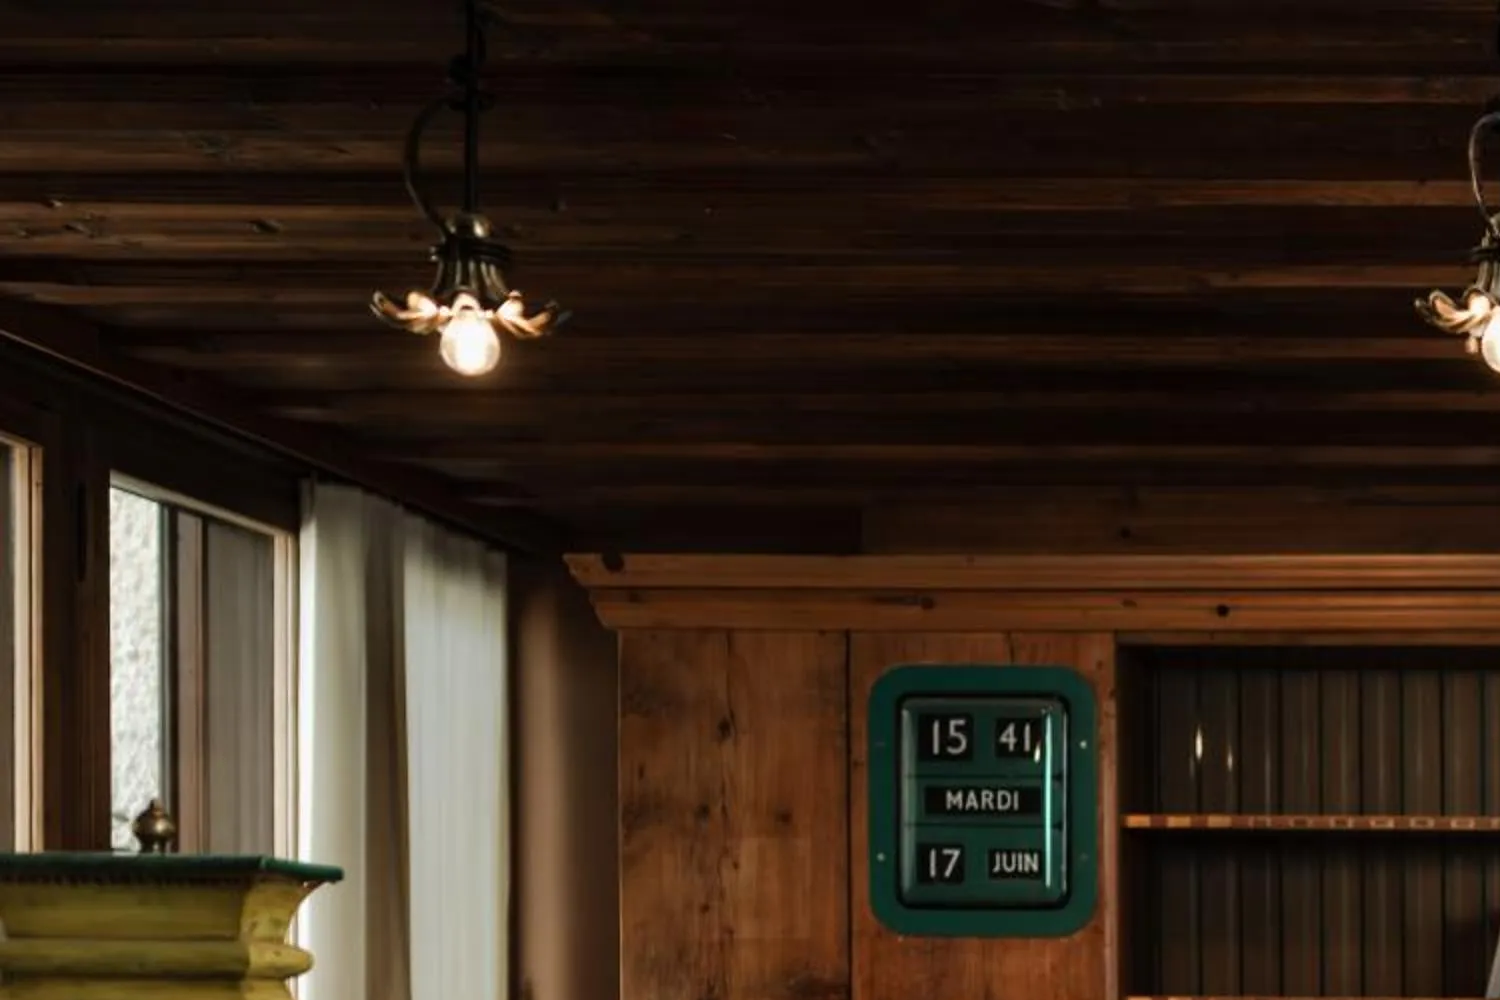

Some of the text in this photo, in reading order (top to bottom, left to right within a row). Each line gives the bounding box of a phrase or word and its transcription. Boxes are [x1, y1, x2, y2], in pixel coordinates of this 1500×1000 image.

[932, 719, 1031, 755] 15 41
[946, 790, 1019, 811] MARDI
[929, 848, 1039, 879] 17 JUIN
